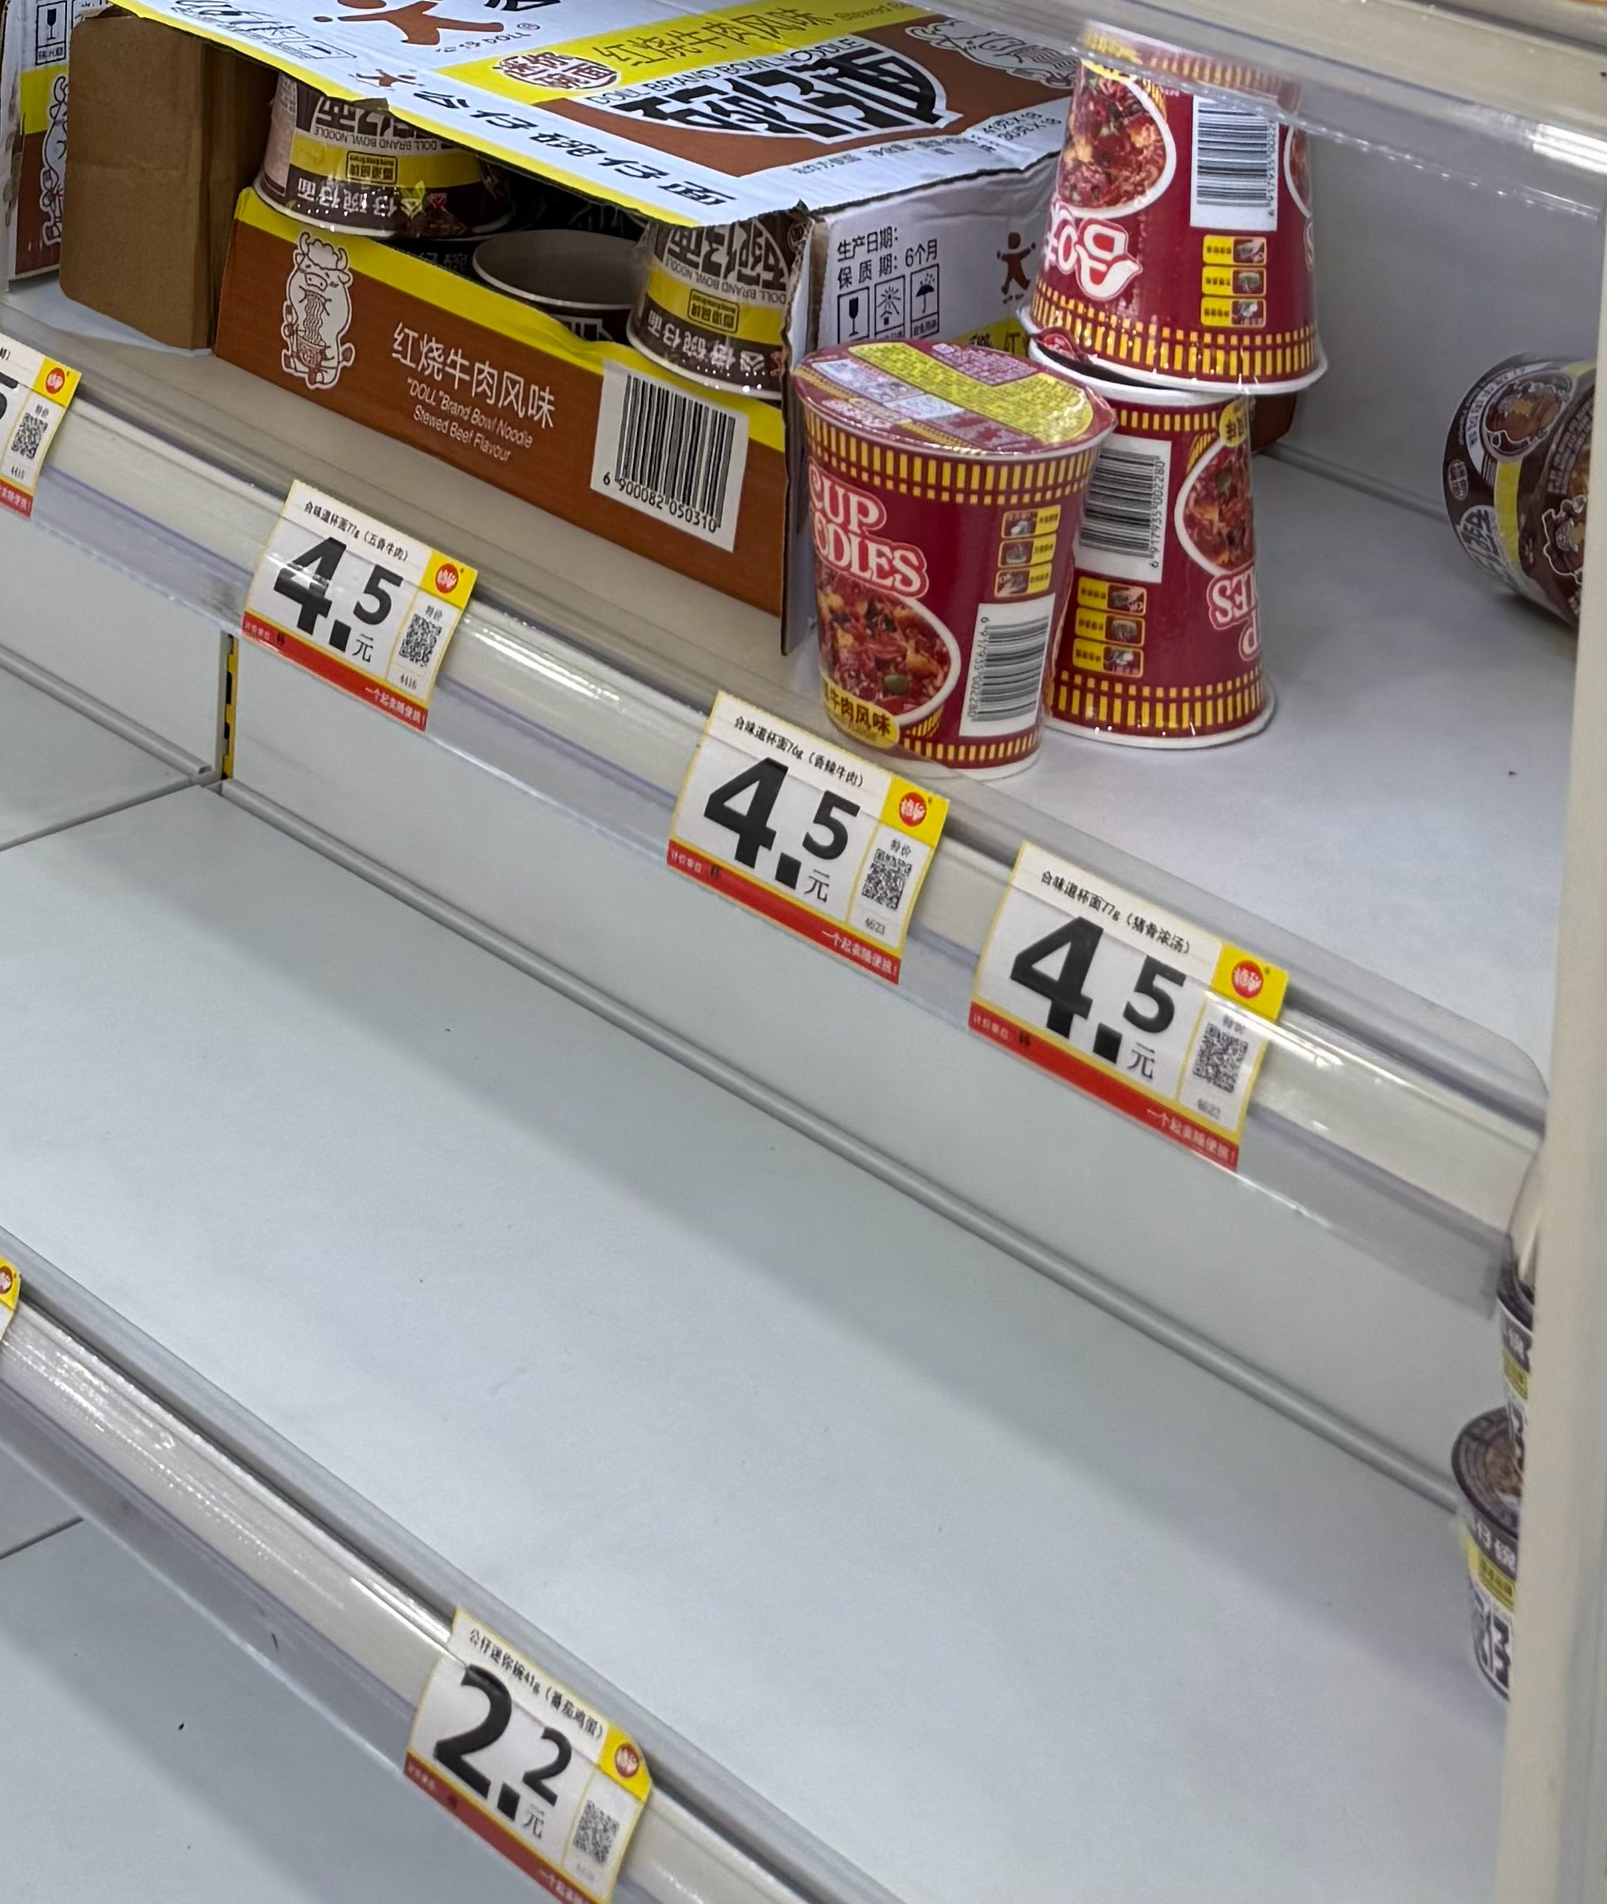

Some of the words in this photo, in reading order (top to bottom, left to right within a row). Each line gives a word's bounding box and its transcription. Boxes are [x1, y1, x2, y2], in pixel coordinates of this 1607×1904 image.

[415, 89, 739, 207] 公仔碗仔面
[837, 227, 899, 263] 生产日期：
[837, 254, 899, 291] 保质期：
[905, 239, 939, 270] 6个月
[392, 322, 556, 430] 红烧牛肉风味
[471, 407, 497, 431] Bowl
[496, 419, 534, 449] Noodle
[413, 405, 450, 434] Stewed
[450, 422, 474, 444] Beef
[474, 432, 512, 462] Flavour
[602, 471, 611, 487] 6
[618, 480, 664, 509] 900082
[669, 503, 717, 534] 050310
[273, 536, 405, 654] 4.5
[352, 632, 375, 664] 元
[703, 756, 862, 892] 4.5
[804, 867, 832, 904] 元
[1009, 916, 1187, 1066] 4.5
[1127, 1041, 1157, 1082] 元
[432, 1662, 572, 1823] 2.2
[523, 1804, 546, 1840] 元
